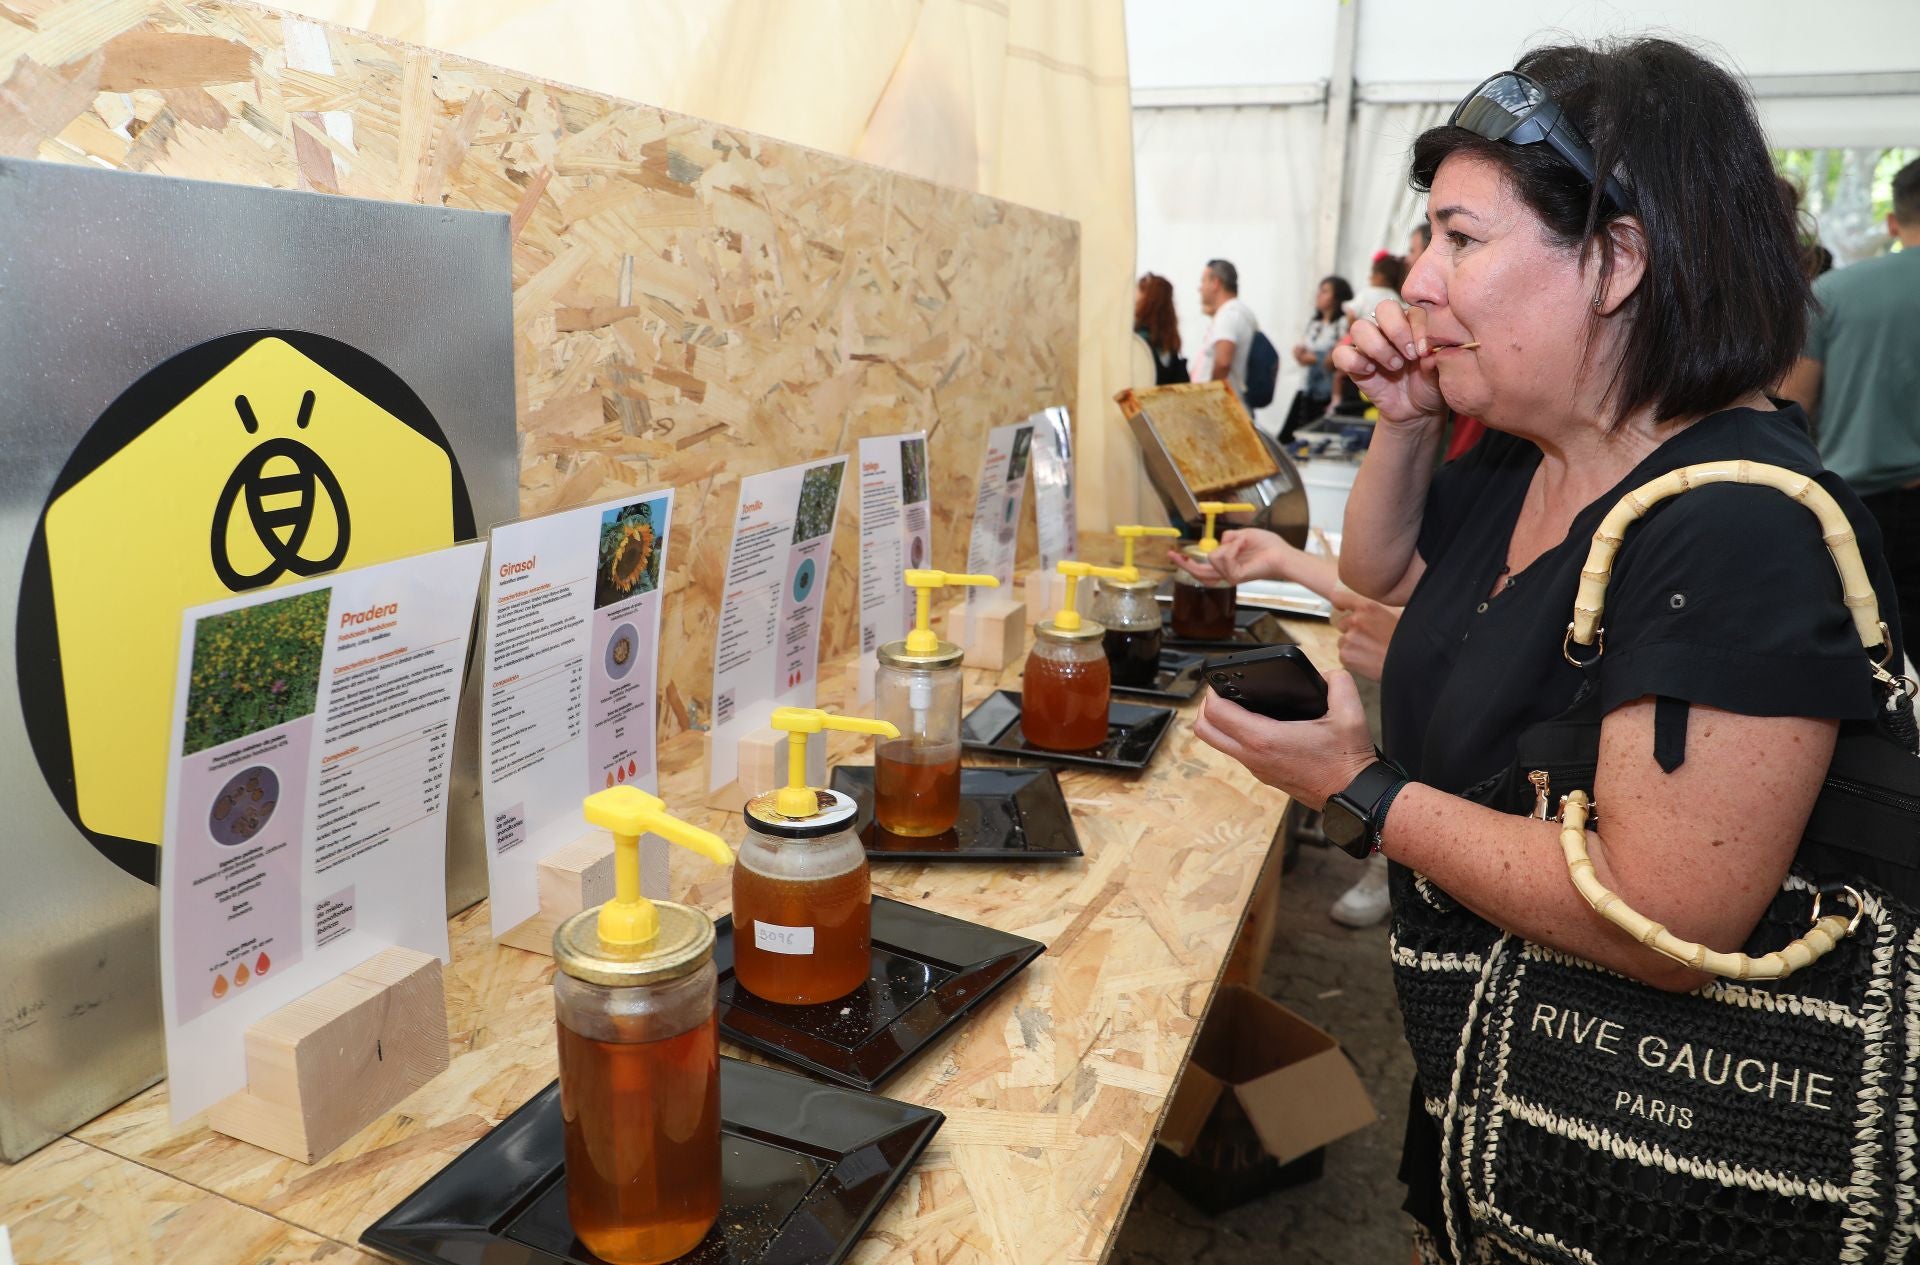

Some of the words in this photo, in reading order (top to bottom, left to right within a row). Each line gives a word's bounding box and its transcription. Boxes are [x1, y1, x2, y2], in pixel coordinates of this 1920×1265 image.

[500, 556, 536, 578] Girasol
[341, 602, 397, 628] Pradera
[1531, 1004, 1624, 1054] RIVE
[1638, 1036, 1834, 1110] GAUCHE
[1616, 1091, 1693, 1129] PARIS
